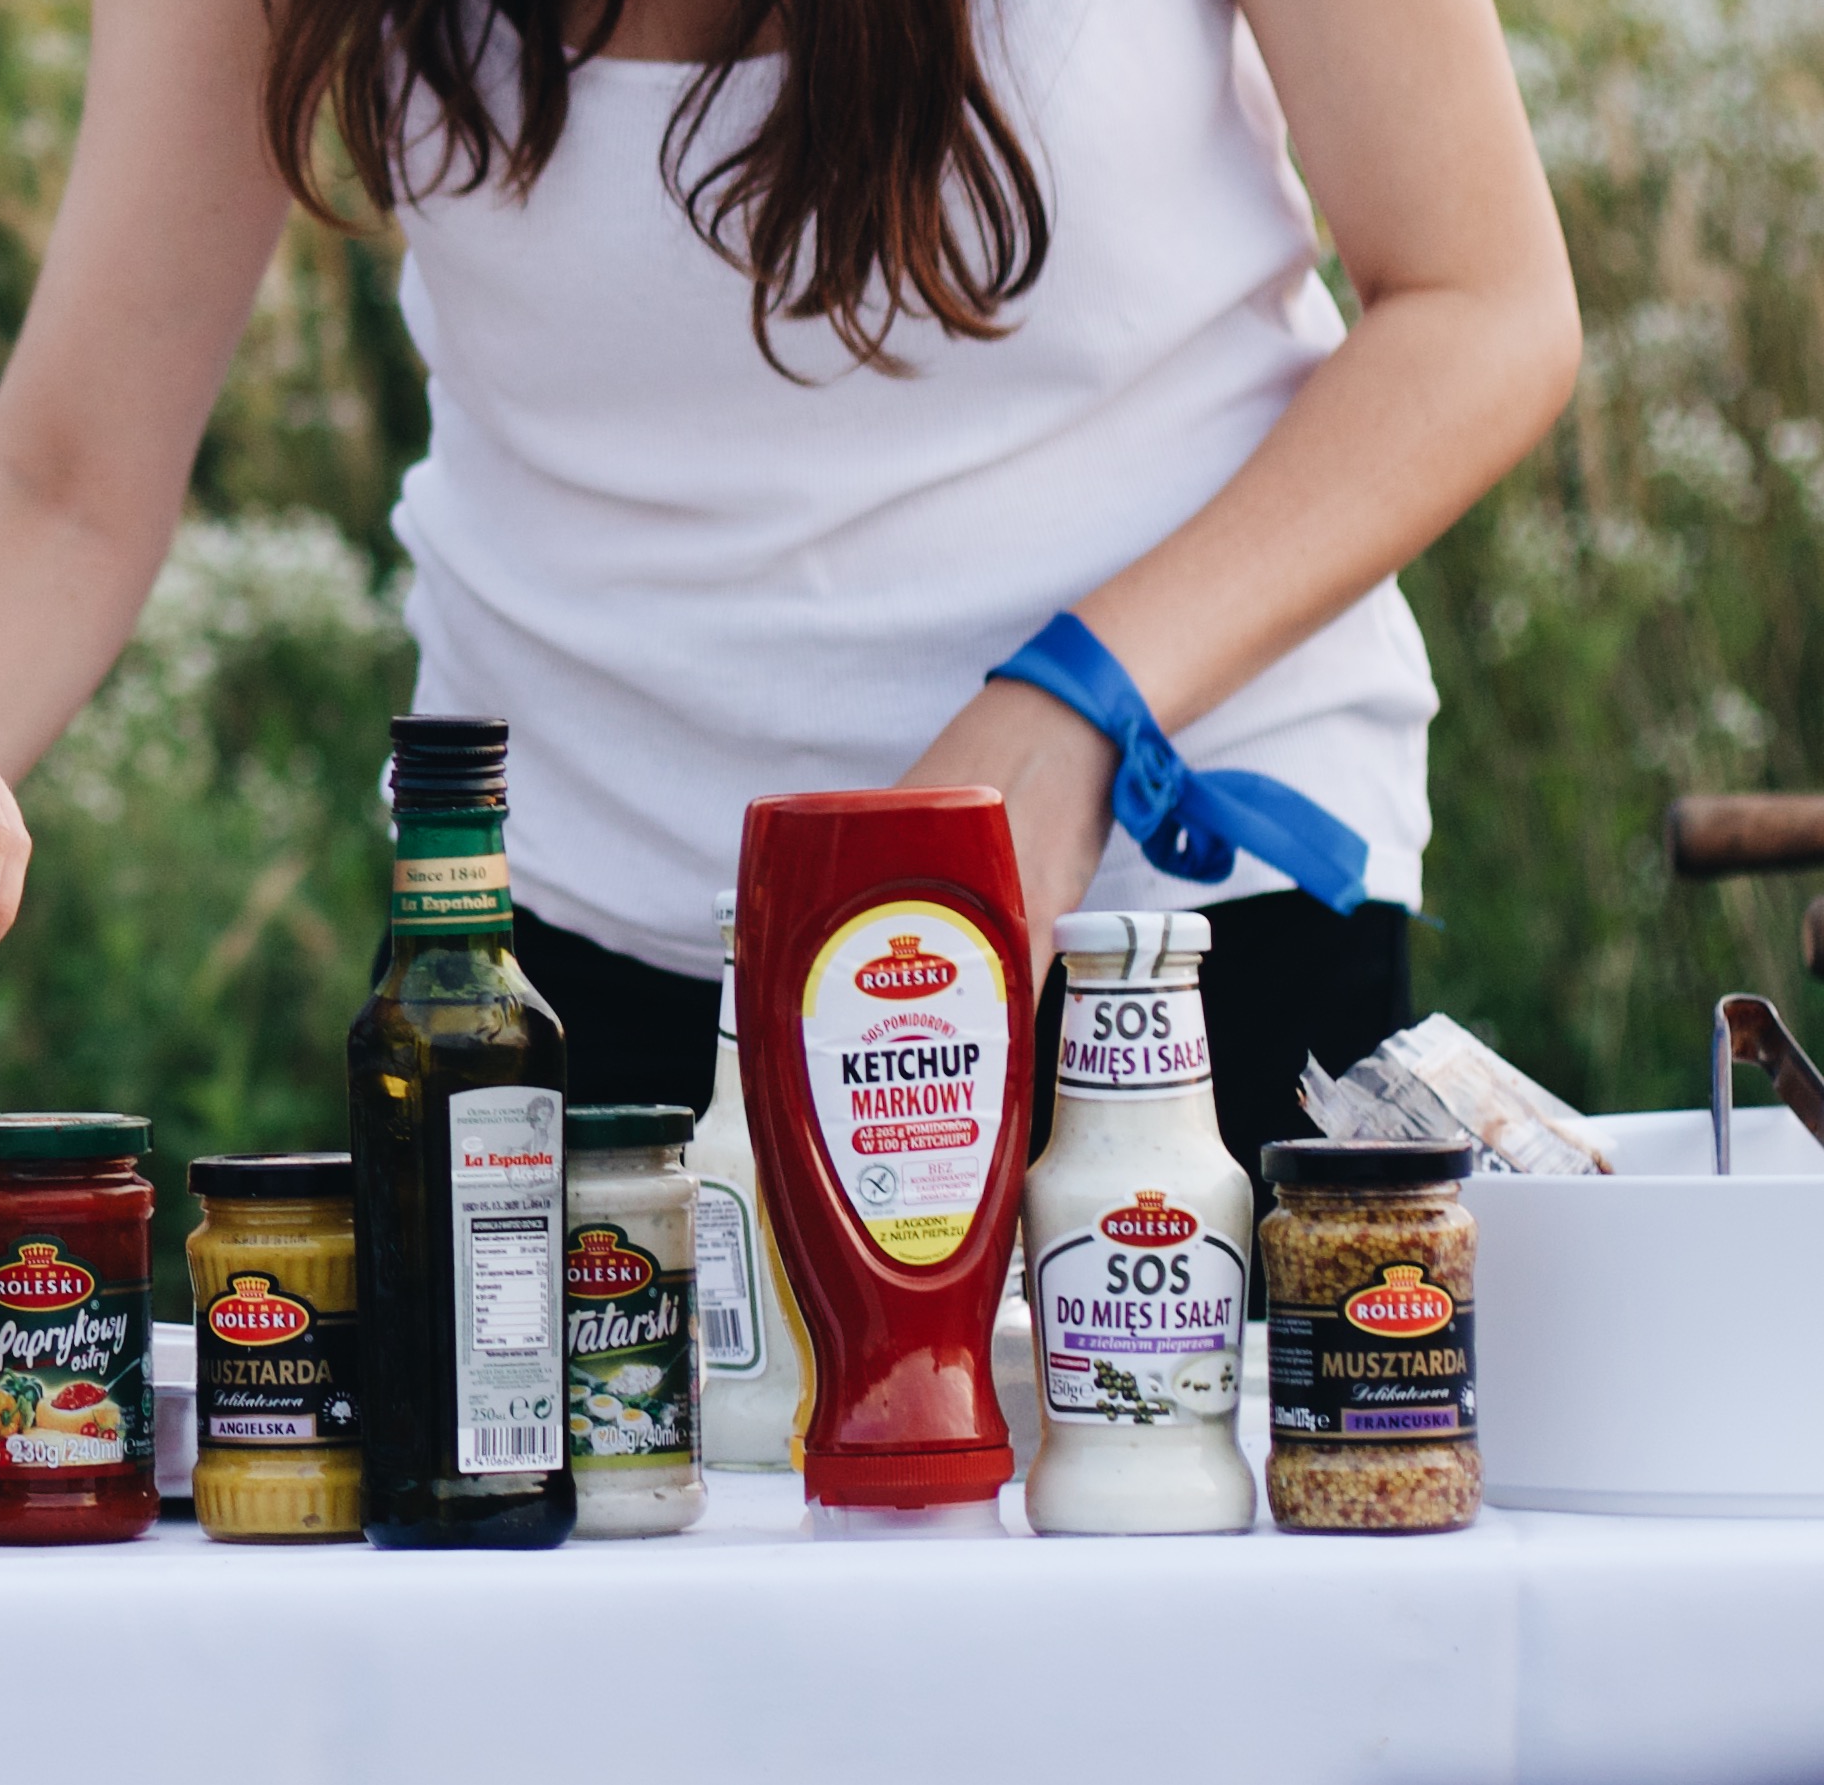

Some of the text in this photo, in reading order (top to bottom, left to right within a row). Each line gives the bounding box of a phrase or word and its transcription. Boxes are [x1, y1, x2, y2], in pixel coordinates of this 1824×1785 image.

[406, 866, 487, 883] Since 1840
[401, 893, 497, 913] La Española
[861, 967, 949, 989] ROLESKI
[861, 1012, 959, 1046] SOS POMIDOROWY
[1093, 1000, 1172, 1041] SOS
[842, 1043, 980, 1085] KETCHUP
[1078, 1043, 1136, 1084] MIĘS
[1143, 1046, 1151, 1075] I
[851, 1080, 975, 1121] MARKOWY
[862, 1140, 875, 1153] W
[877, 1138, 899, 1152] 100
[909, 1131, 971, 1149] KETCHUPU
[464, 1151, 553, 1168] La Española
[895, 1214, 949, 1230] ŁAGODNY
[1107, 1219, 1190, 1236] ROLESKI
[922, 1226, 965, 1240] PIEPRZU
[11, 1271, 71, 1280] FIRMA
[567, 1266, 641, 1283] OLESKI
[1106, 1253, 1192, 1295] SOS
[228, 1303, 283, 1312] FIRMA
[1057, 1296, 1232, 1337] DO MIĘS I SAŁAT
[1356, 1301, 1443, 1320] ROLESKI
[215, 1312, 297, 1329] ROLESKI
[568, 1291, 680, 1357] Tatarski
[1077, 1336, 1215, 1352] z zielonym pieprzem
[71, 1344, 110, 1375] ostry
[1321, 1348, 1467, 1379] MUSZTARDA
[213, 1388, 304, 1408] Delikatesowa
[1352, 1383, 1450, 1402] Delikatesowa
[218, 1421, 297, 1436] ANGIELSKA
[1355, 1414, 1452, 1431] FRANCUSKA
